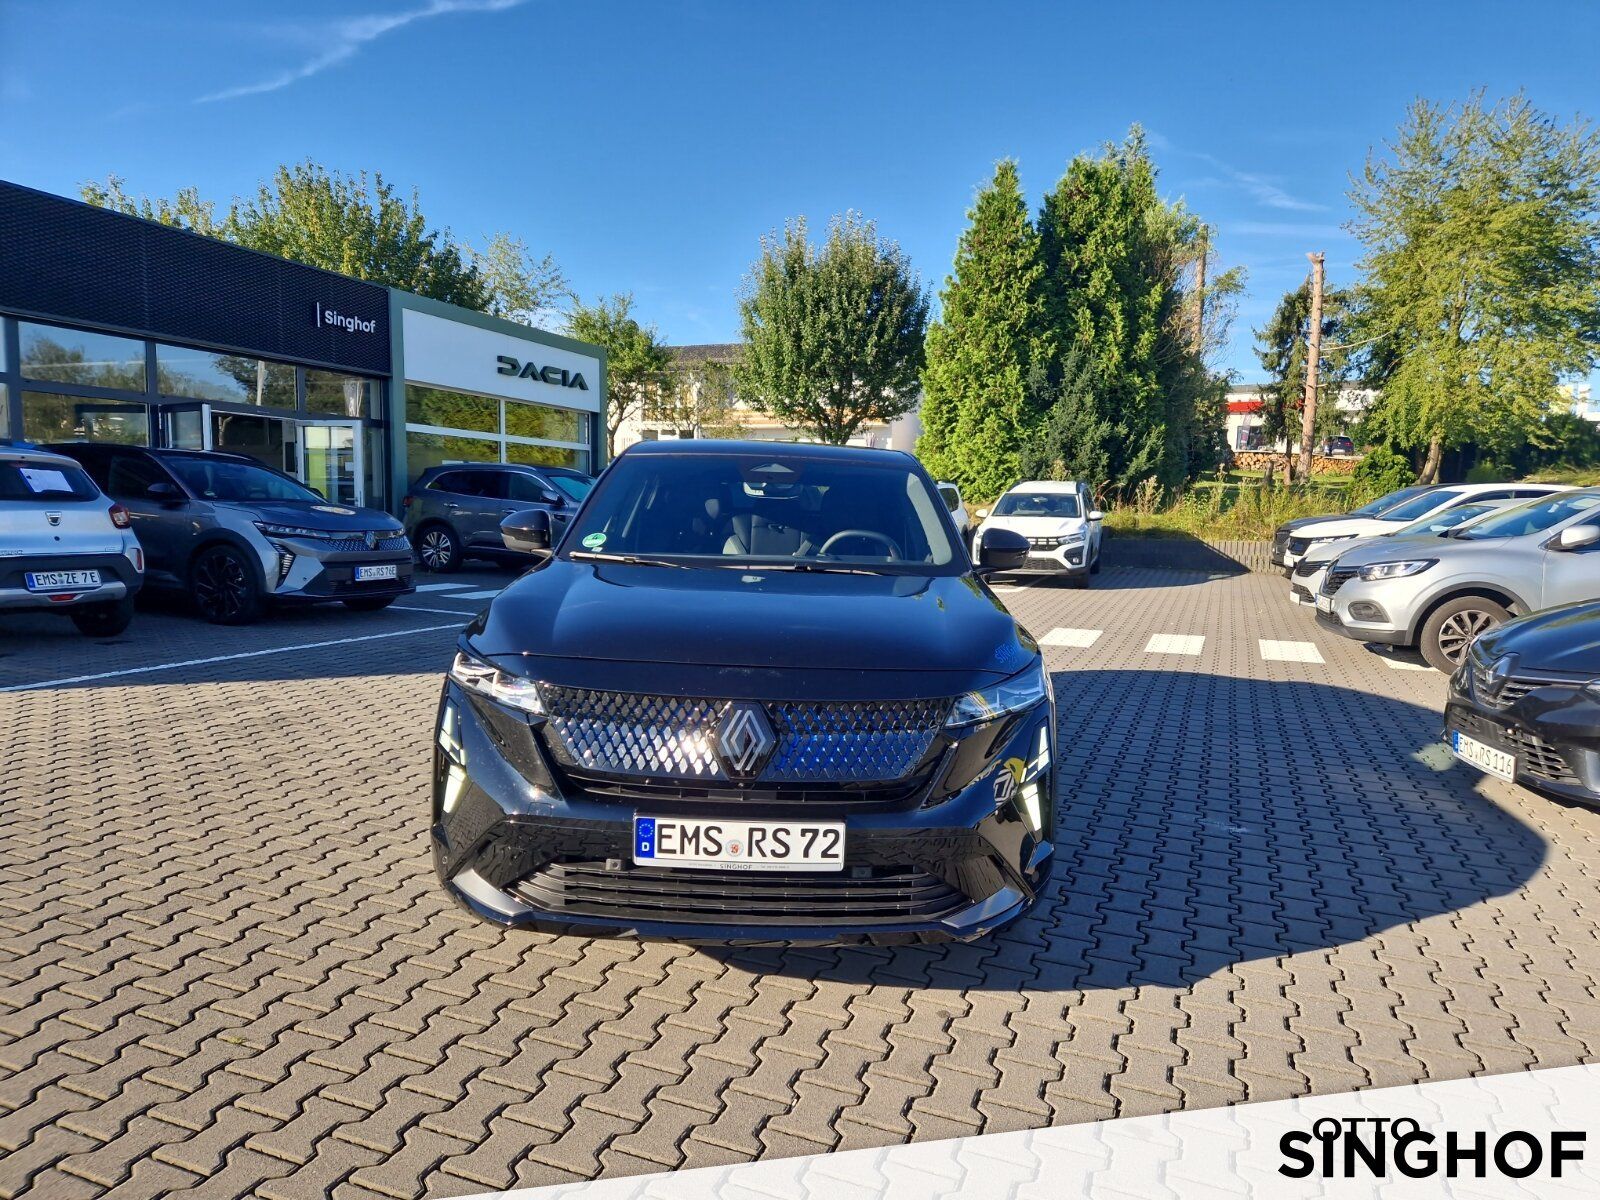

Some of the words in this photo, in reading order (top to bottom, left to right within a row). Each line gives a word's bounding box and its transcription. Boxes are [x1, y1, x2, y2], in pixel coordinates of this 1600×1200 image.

[324, 310, 376, 334] Singhof
[496, 355, 589, 391] DACIA
[35, 573, 58, 586] EMS
[64, 572, 79, 584] ZE
[359, 568, 373, 578] EMS
[1479, 746, 1491, 766] RS
[1492, 753, 1512, 775] 116
[641, 841, 650, 852] D
[657, 824, 723, 857] EMS
[747, 827, 791, 858] RS
[800, 828, 841, 859] 72
